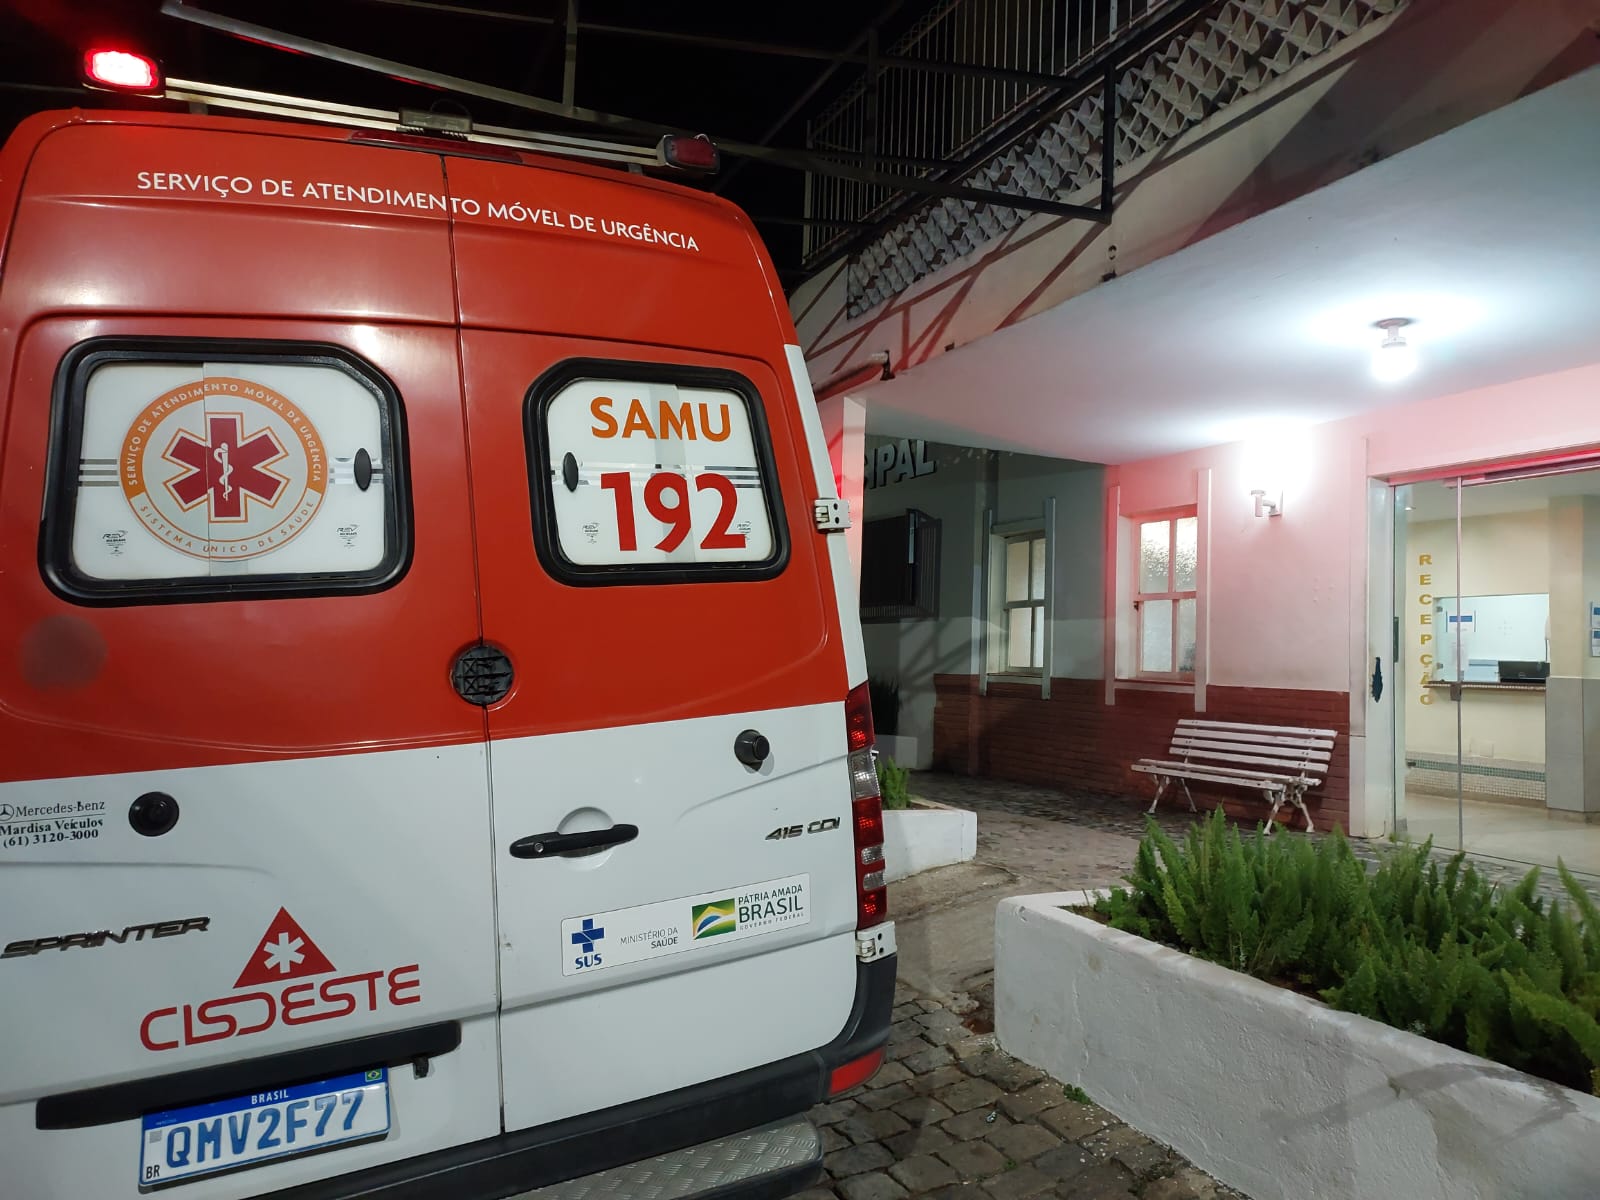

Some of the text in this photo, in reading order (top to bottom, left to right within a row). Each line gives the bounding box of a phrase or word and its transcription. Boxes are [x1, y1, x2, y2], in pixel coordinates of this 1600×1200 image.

[136, 171, 700, 252] SERVIÇO DE ATENDIMENTO MÓVEL DE URGÊNCIA
[590, 396, 731, 442] SAMU
[127, 436, 141, 486] SERVIÇO
[137, 418, 152, 433] DE
[151, 383, 239, 418] ATENDIMENTO
[286, 409, 301, 425] DE
[864, 438, 936, 488] IPAL
[600, 471, 747, 554] 192
[140, 504, 193, 548] SISTEMA
[257, 536, 274, 548] DE
[15, 801, 105, 818] Mercedes-Benz
[0, 817, 104, 836] Mardisa Veículos
[3, 828, 99, 849] (61) 3120-3000
[765, 817, 841, 841] 415 CDI
[738, 884, 803, 905] PÁTRIA AMADA
[738, 895, 804, 923] BRASIL
[0, 916, 210, 959] SPRINTER
[620, 927, 679, 945] MINISTÉRIO DA
[651, 936, 679, 949] SAÚDE
[575, 953, 603, 969] SUS
[140, 964, 421, 1051] CISDESTE
[251, 1089, 289, 1104] BRASIL
[166, 1090, 364, 1168] QMV2F77
[146, 1166, 160, 1179] BR
